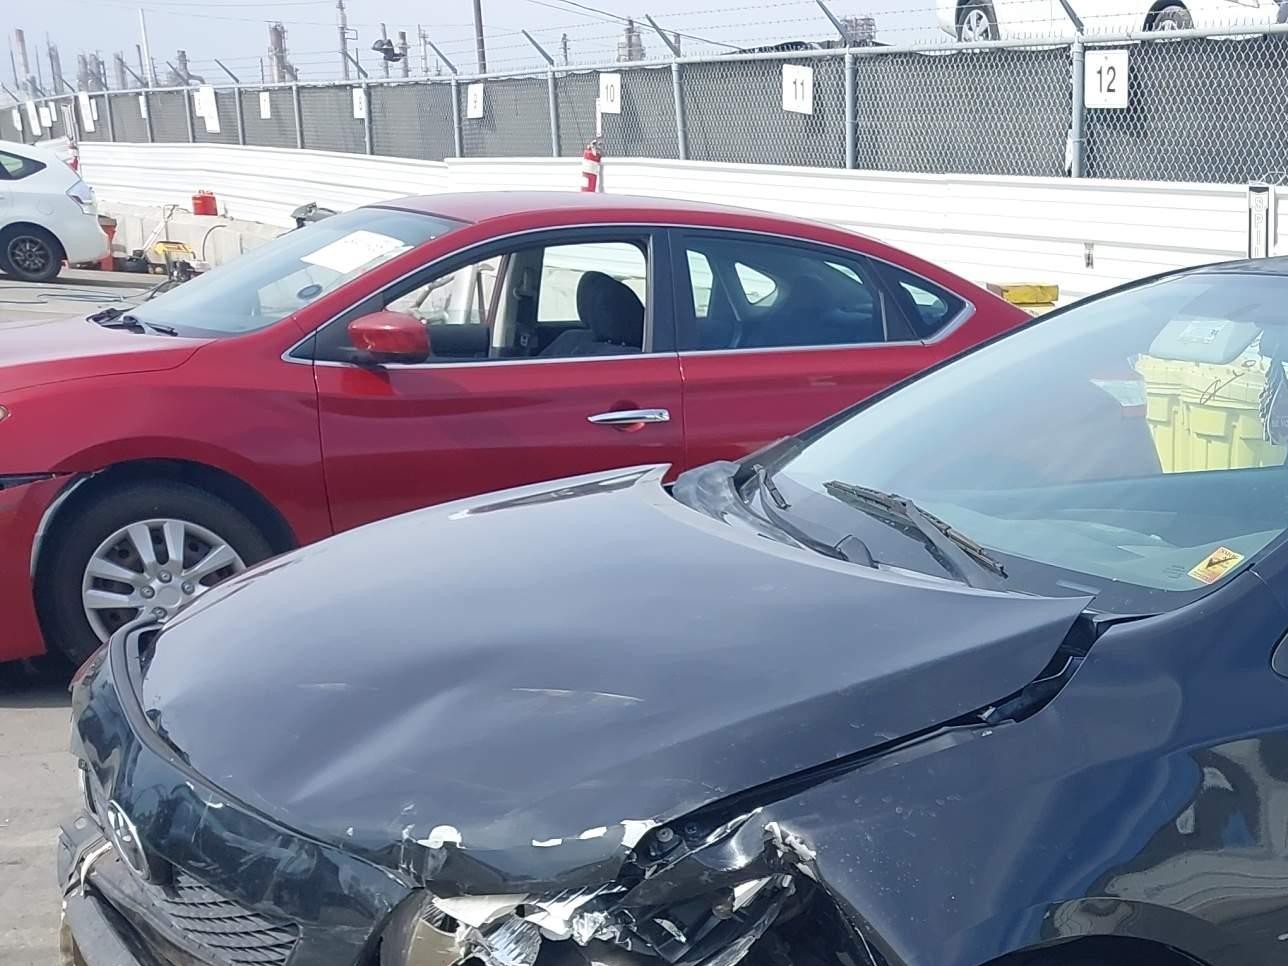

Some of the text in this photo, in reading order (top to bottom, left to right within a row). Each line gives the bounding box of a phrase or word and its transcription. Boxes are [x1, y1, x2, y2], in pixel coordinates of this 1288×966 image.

[793, 78, 805, 101] 11
[1096, 66, 1116, 93] 12
[605, 84, 615, 102] 10
